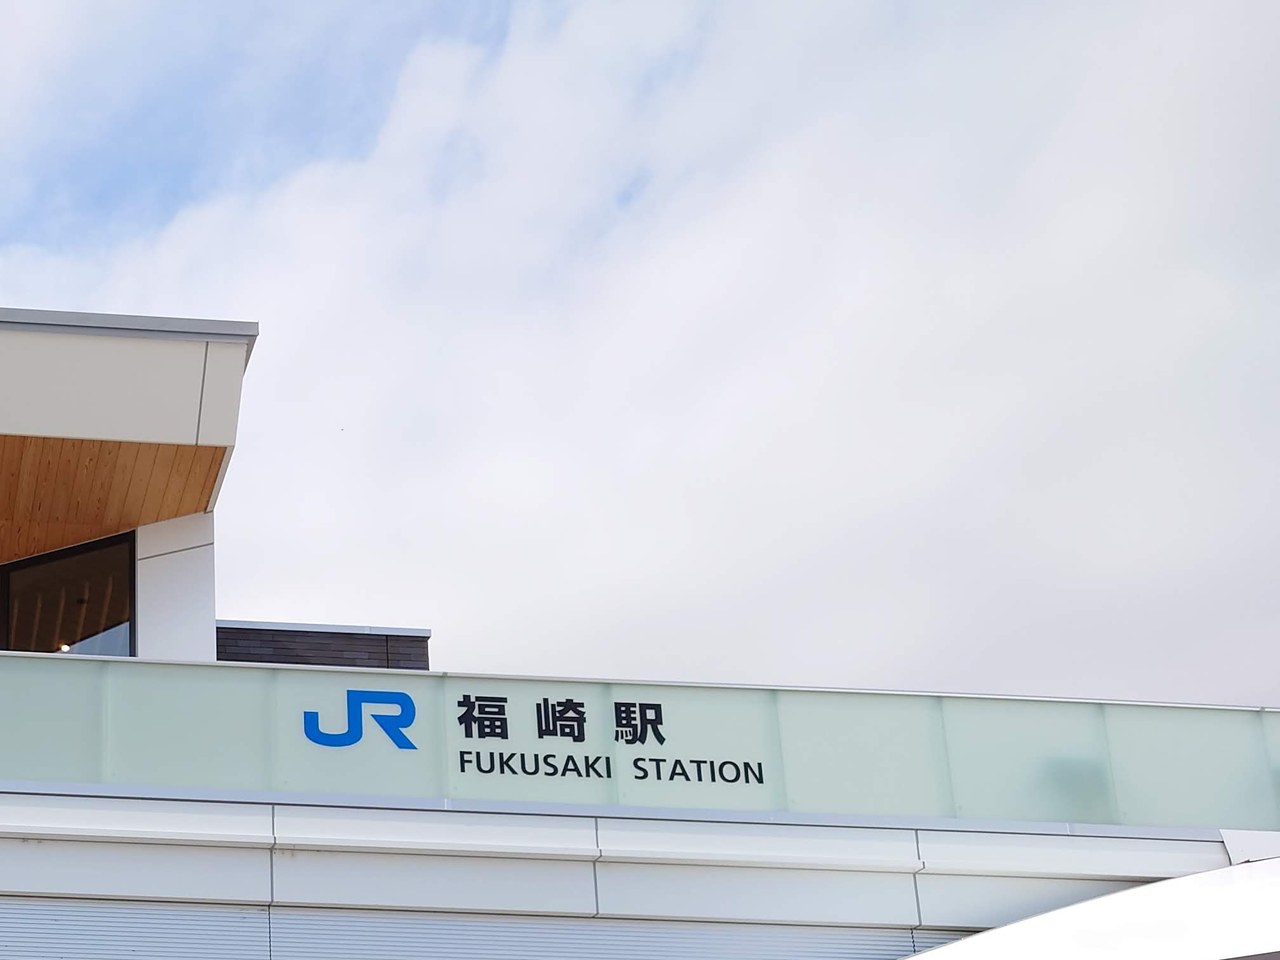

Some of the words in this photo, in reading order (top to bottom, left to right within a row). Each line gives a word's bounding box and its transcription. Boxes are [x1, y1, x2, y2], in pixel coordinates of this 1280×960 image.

[303, 689, 418, 750] JR
[457, 694, 666, 745] 福崎駅
[458, 751, 612, 779] FUKUSAKI
[632, 757, 765, 785] STATION
